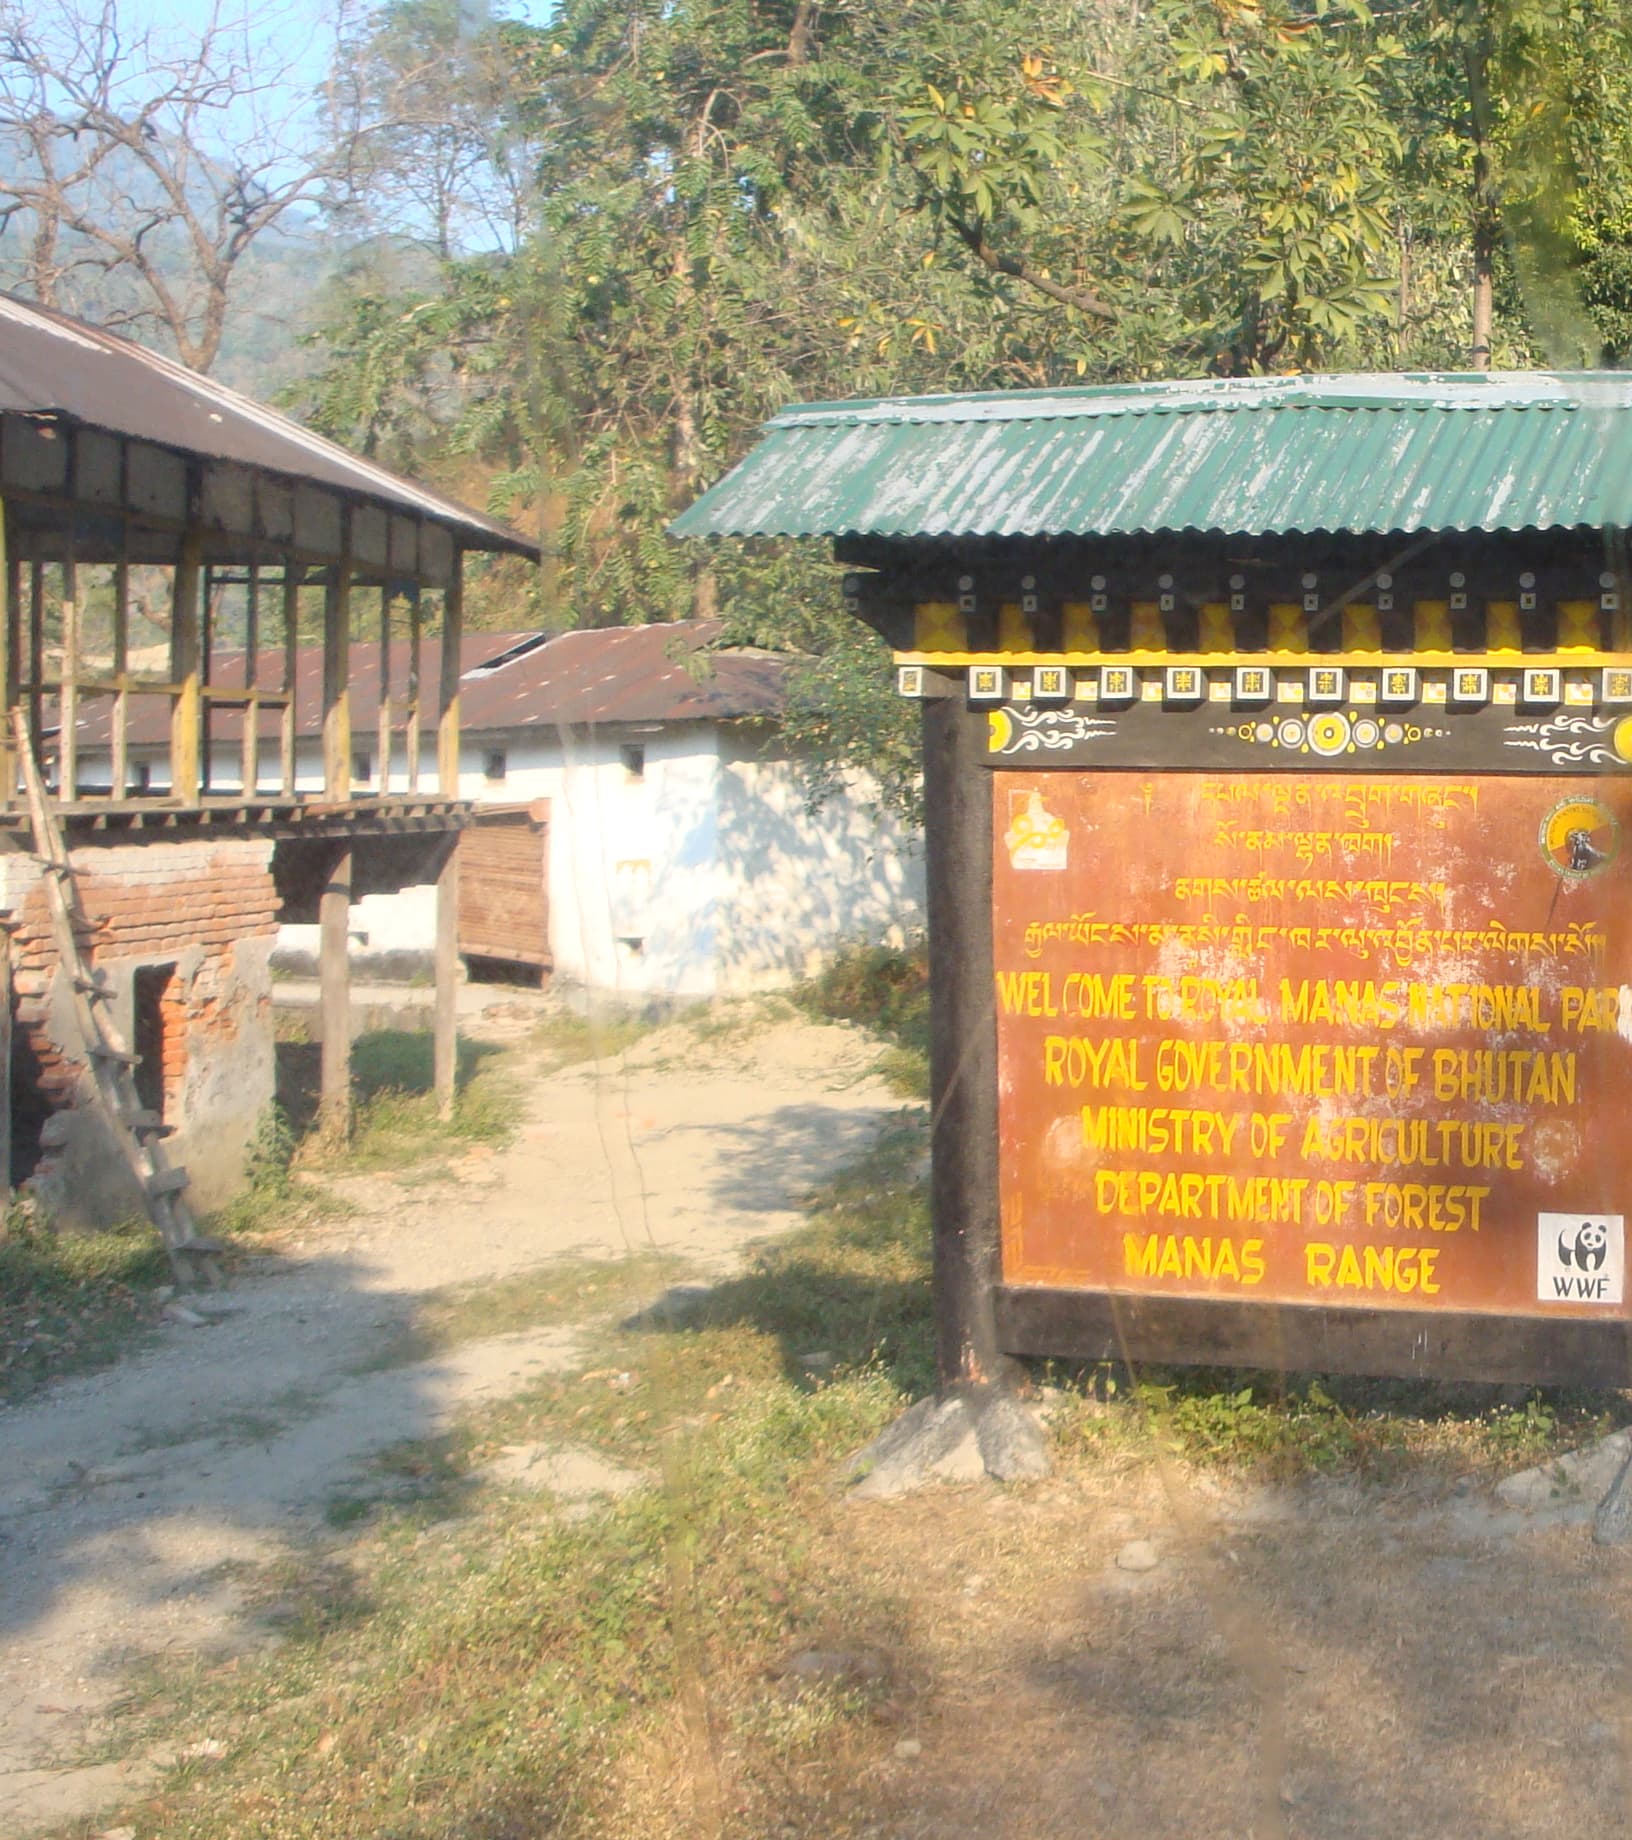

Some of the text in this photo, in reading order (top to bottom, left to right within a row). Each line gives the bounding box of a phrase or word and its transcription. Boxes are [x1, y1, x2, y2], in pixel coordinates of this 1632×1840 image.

[1142, 975, 1173, 1021] TO
[1180, 976, 1269, 1024] ROYAL
[1279, 978, 1400, 1029] MANAS
[1408, 983, 1551, 1033] NATIONAL
[1044, 1036, 1576, 1105] ROYAL GOVERNMENT OF BHUTAN
[1081, 1105, 1525, 1170] MINISTRY OF AGRICULTURE
[1095, 1170, 1490, 1232] DEPARTMENT OF FOREST
[1123, 1232, 1440, 1294] MANAS RANGE
[1553, 1276, 1610, 1299] WWF
